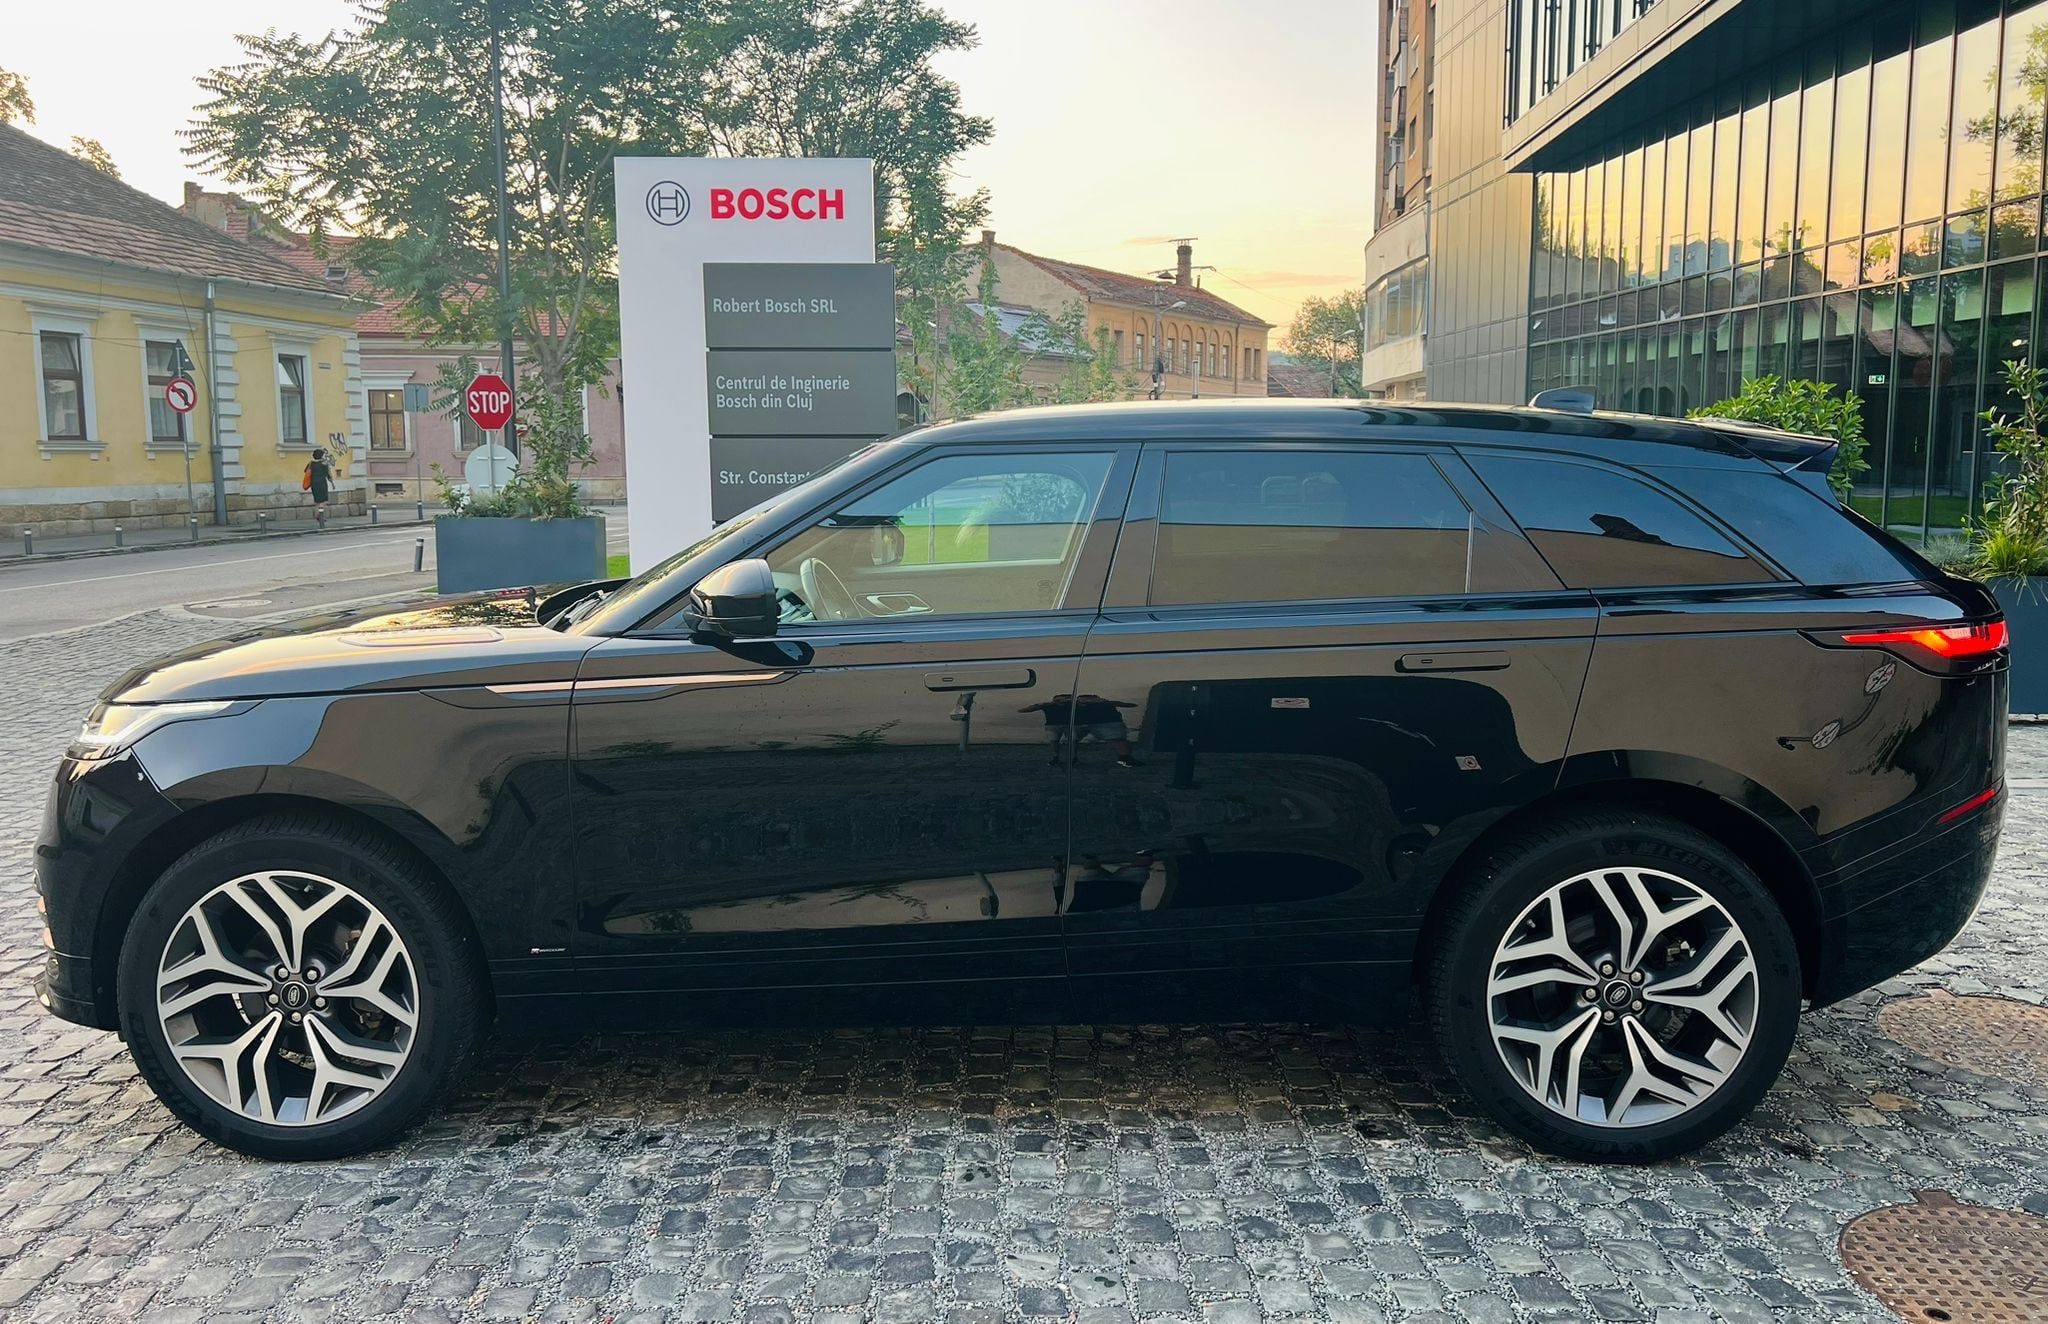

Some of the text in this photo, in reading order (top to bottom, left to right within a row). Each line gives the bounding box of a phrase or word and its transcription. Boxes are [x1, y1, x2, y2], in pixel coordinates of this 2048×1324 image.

[710, 188, 844, 220] BOSCH
[712, 298, 838, 313] Robert Bosch SRL
[715, 375, 850, 393] Centrul de Inginerie
[469, 390, 510, 414] STOP
[716, 393, 813, 410] Bosch din Cluj
[719, 470, 744, 484] Str.
